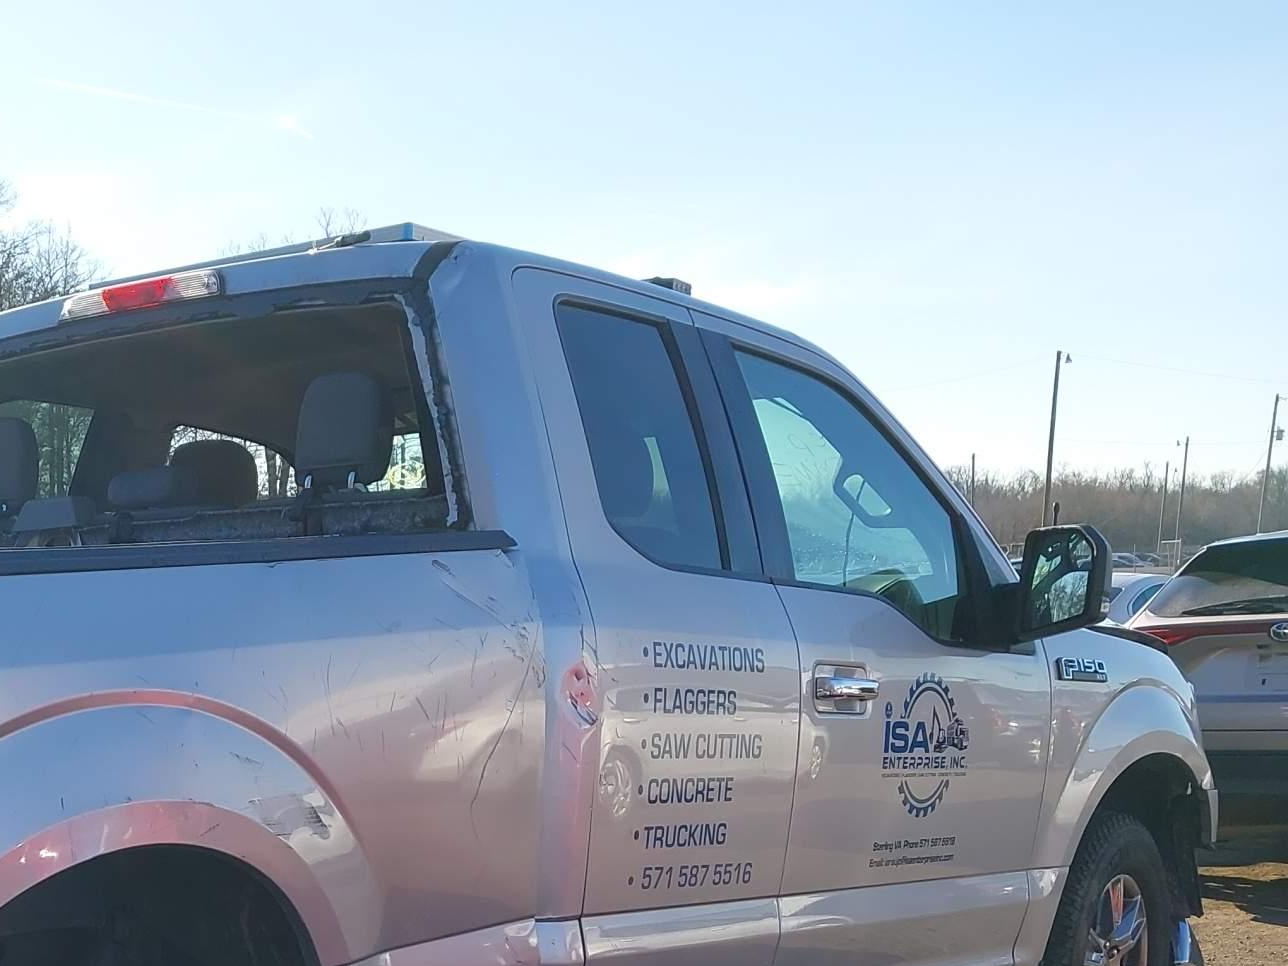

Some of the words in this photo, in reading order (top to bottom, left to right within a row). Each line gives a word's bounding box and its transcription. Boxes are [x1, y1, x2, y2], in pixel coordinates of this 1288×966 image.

[652, 642, 765, 673] EXCAVATIONS
[1062, 657, 1106, 679] F150
[653, 688, 737, 716] FLAGGERS
[650, 732, 693, 760] SAW
[695, 733, 763, 760] CUTTING
[881, 756, 948, 770] ENTERPRISE,
[647, 777, 734, 805] CONCRETE
[644, 823, 727, 850] TRUCKING
[641, 866, 674, 890] 571
[677, 864, 710, 888] 587
[712, 862, 753, 887] 5516
